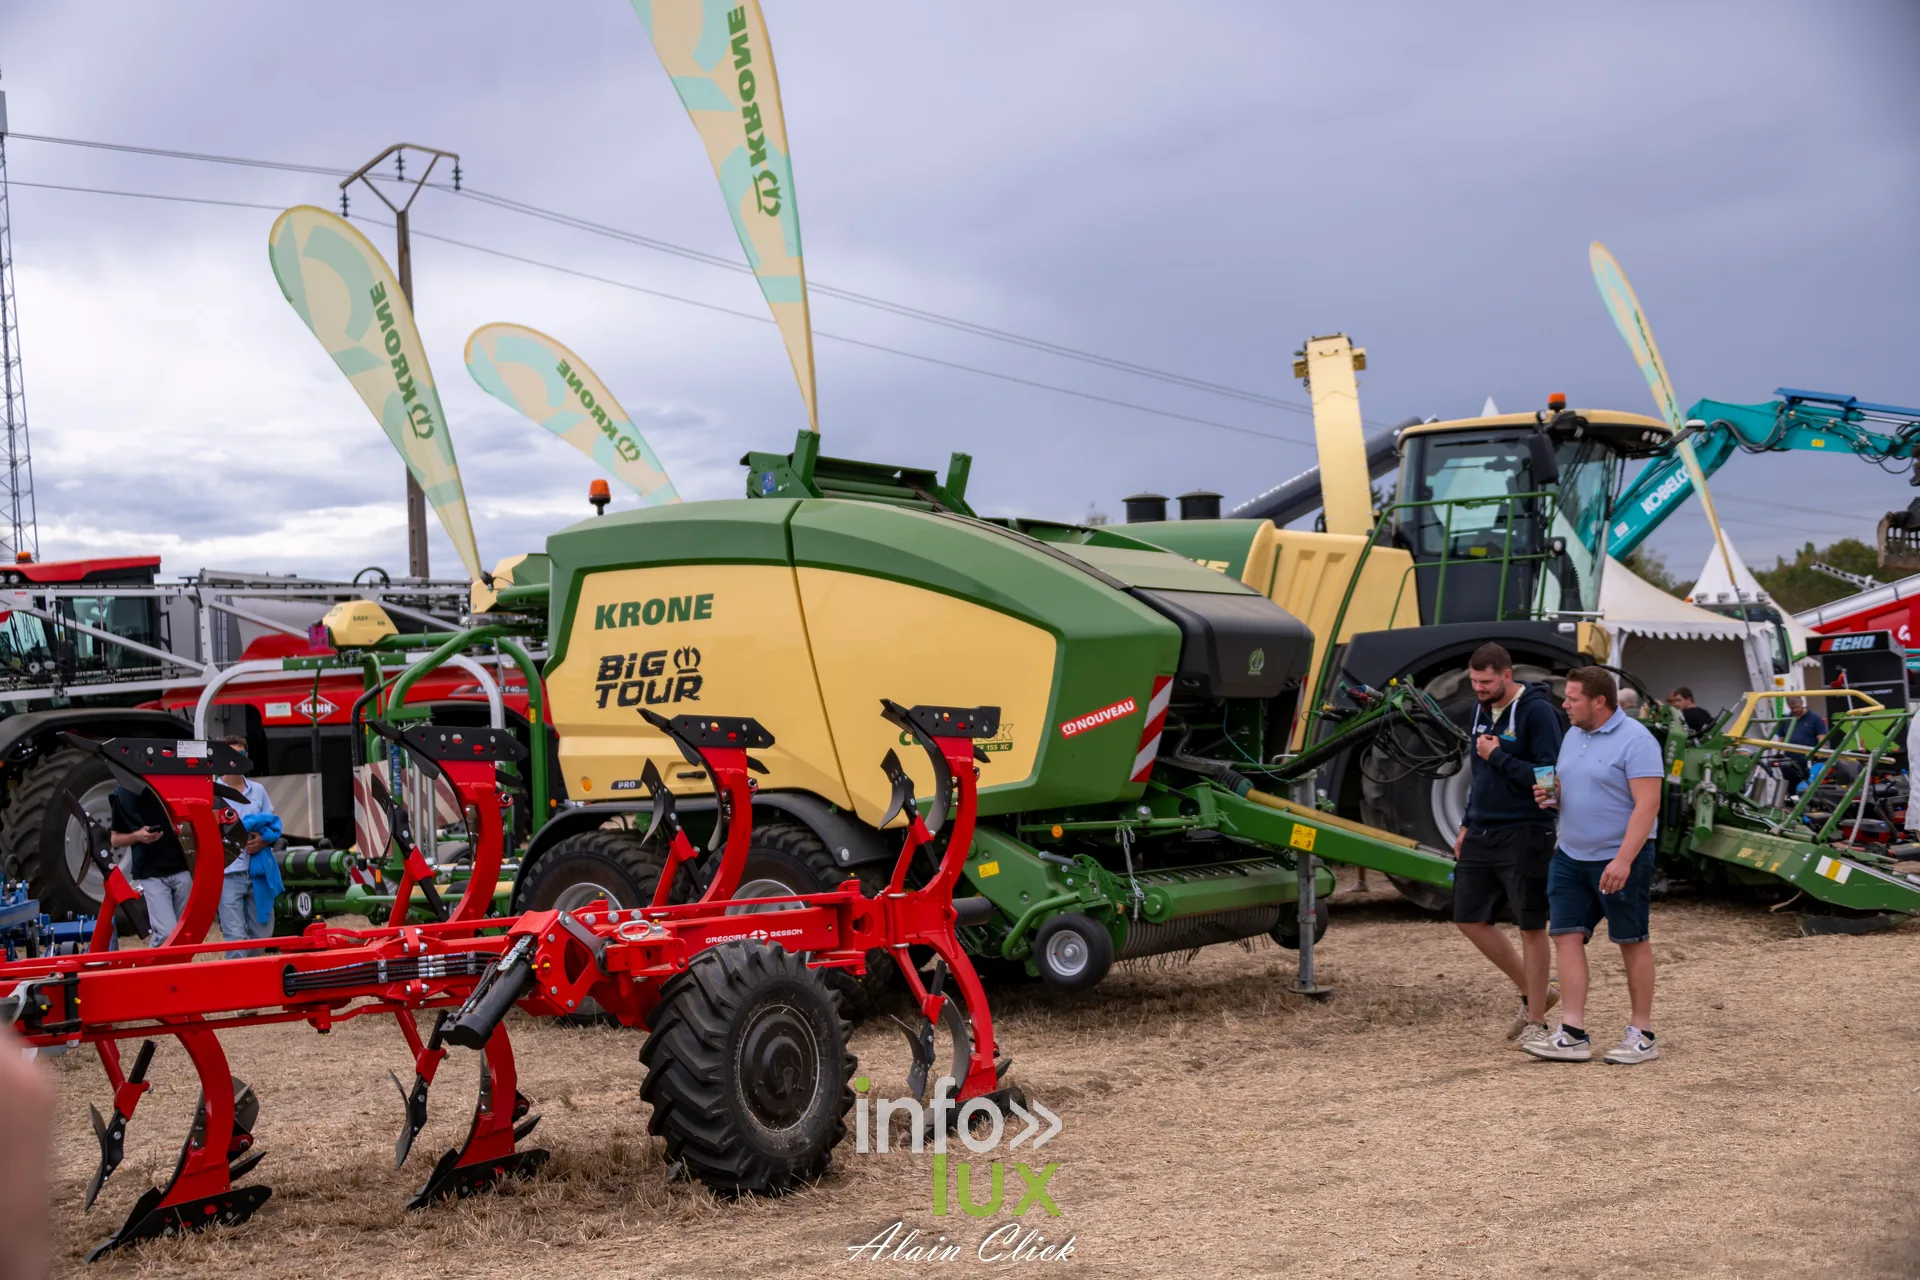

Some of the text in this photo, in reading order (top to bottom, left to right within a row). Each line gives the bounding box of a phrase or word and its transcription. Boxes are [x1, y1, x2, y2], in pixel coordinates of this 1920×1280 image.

[594, 593, 714, 630] KRONE
[1831, 635, 1876, 651] ECHO
[594, 675, 703, 709] TOUR
[1076, 700, 1134, 730] NOUVEAU
[618, 781, 635, 789] PRO
[300, 896, 310, 911] 40
[770, 928, 803, 937] BESSON
